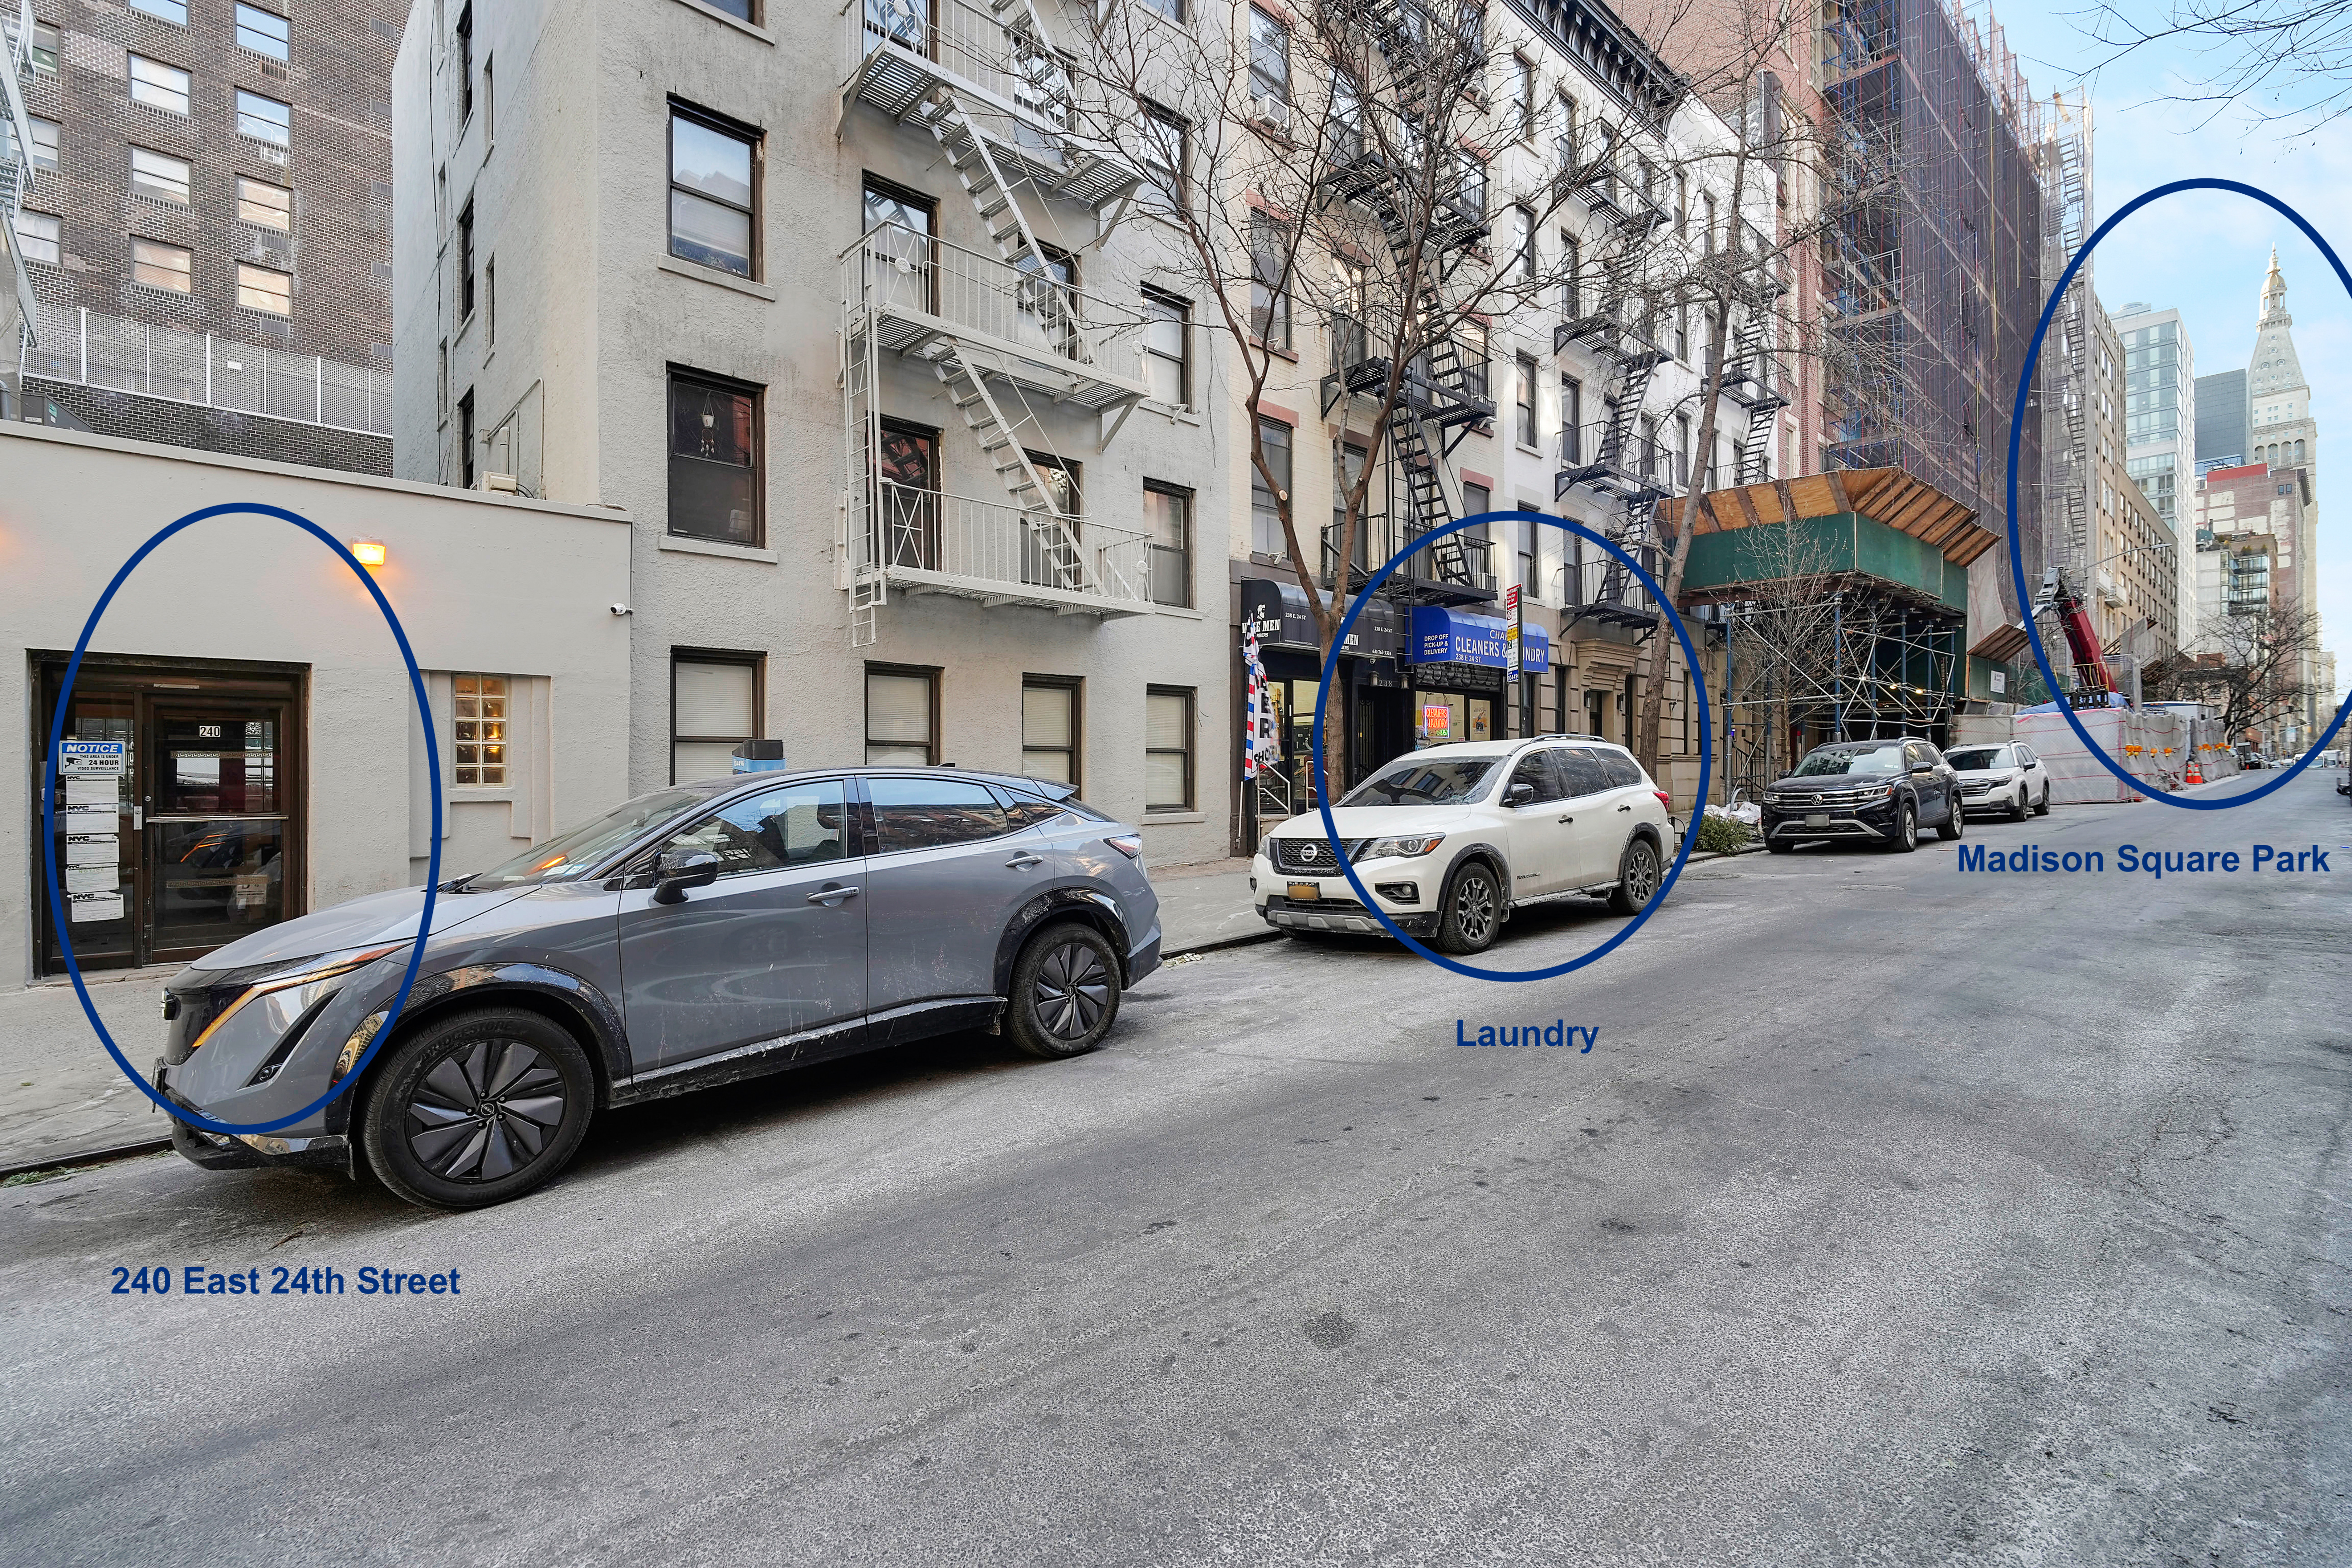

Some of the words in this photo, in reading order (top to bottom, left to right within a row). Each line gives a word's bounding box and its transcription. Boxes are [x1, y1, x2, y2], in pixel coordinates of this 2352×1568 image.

[1262, 619, 1280, 632] MEN
[1455, 636, 1499, 658] CLEANERS
[1501, 643, 1507, 658] &
[1426, 707, 1447, 718] CLEANERS
[1429, 718, 1447, 728] LAUNDRY
[200, 726, 220, 736] 240
[67, 744, 118, 753] NOTICE
